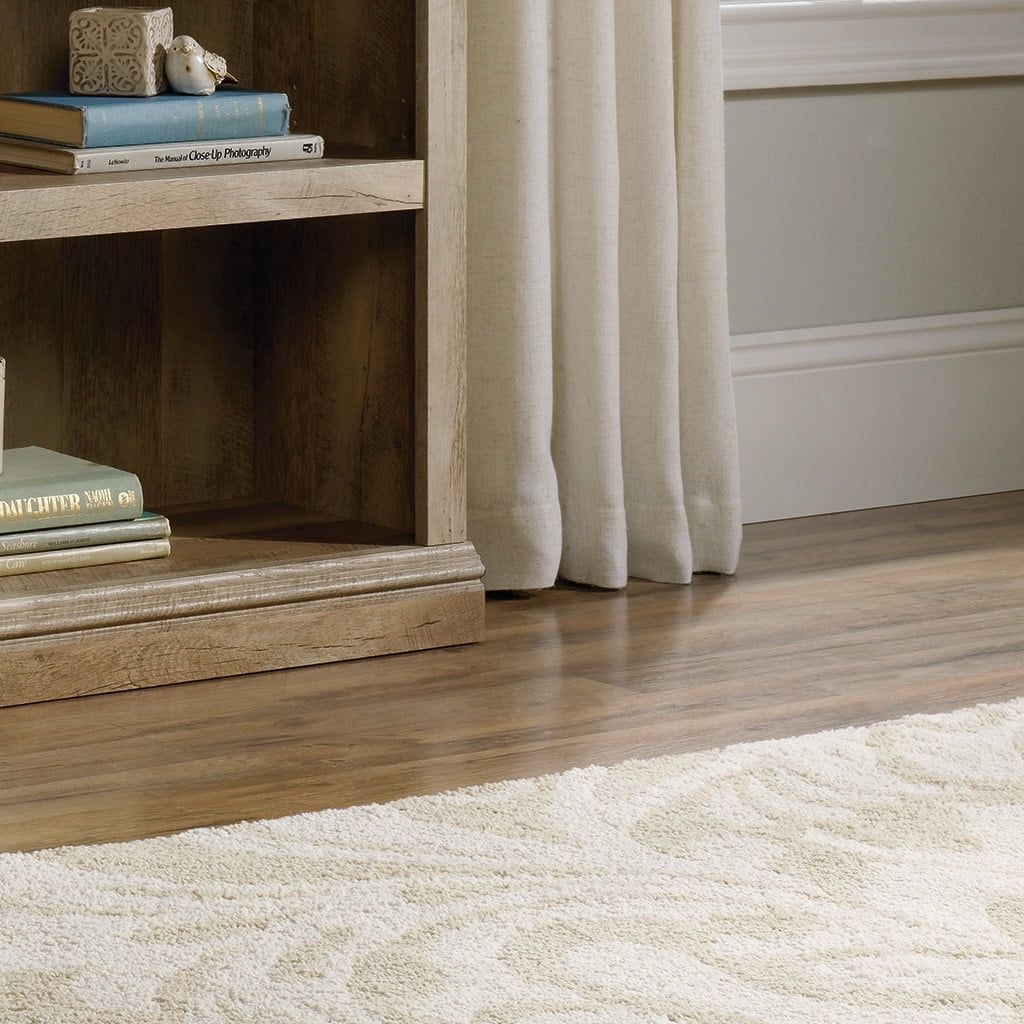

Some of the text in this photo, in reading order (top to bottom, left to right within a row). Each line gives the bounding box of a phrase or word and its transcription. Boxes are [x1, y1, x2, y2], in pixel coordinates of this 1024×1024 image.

[165, 154, 182, 163] Manual
[224, 145, 272, 160] Photography
[1, 538, 39, 552] Seashore
